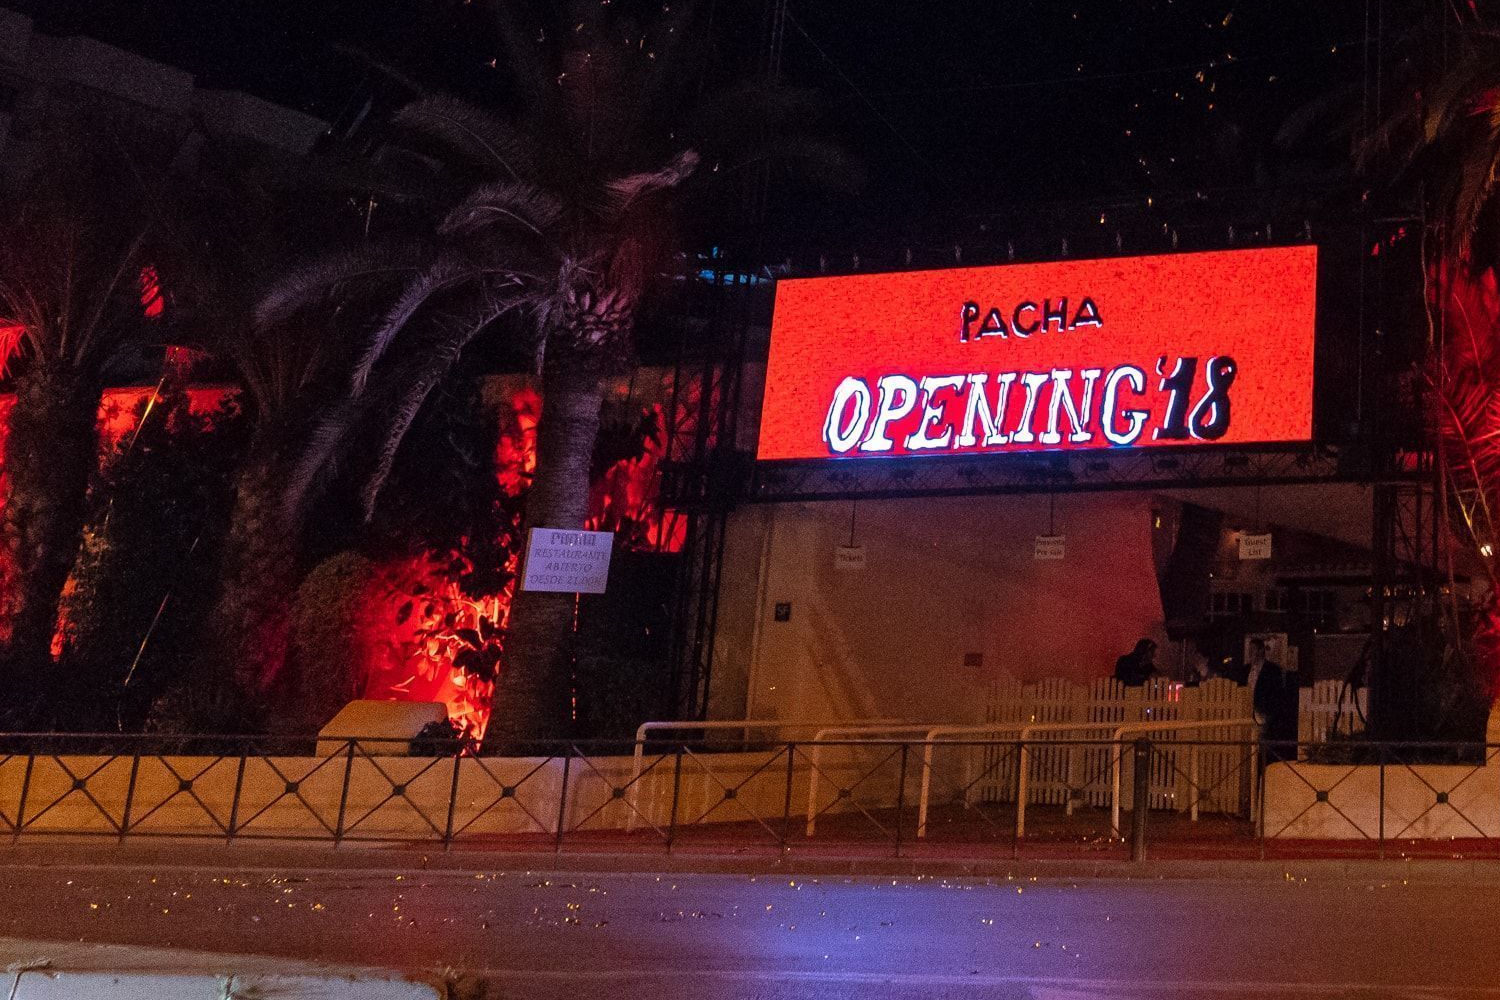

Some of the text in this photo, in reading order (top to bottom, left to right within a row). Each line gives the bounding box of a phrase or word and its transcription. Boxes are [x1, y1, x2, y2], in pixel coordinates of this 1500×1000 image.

[959, 295, 1104, 343] PACHA
[1244, 538, 1267, 546] Guest
[534, 548, 607, 561] RESTAURANTE
[545, 562, 593, 572] ABIERTO
[530, 574, 563, 585] DESDE
